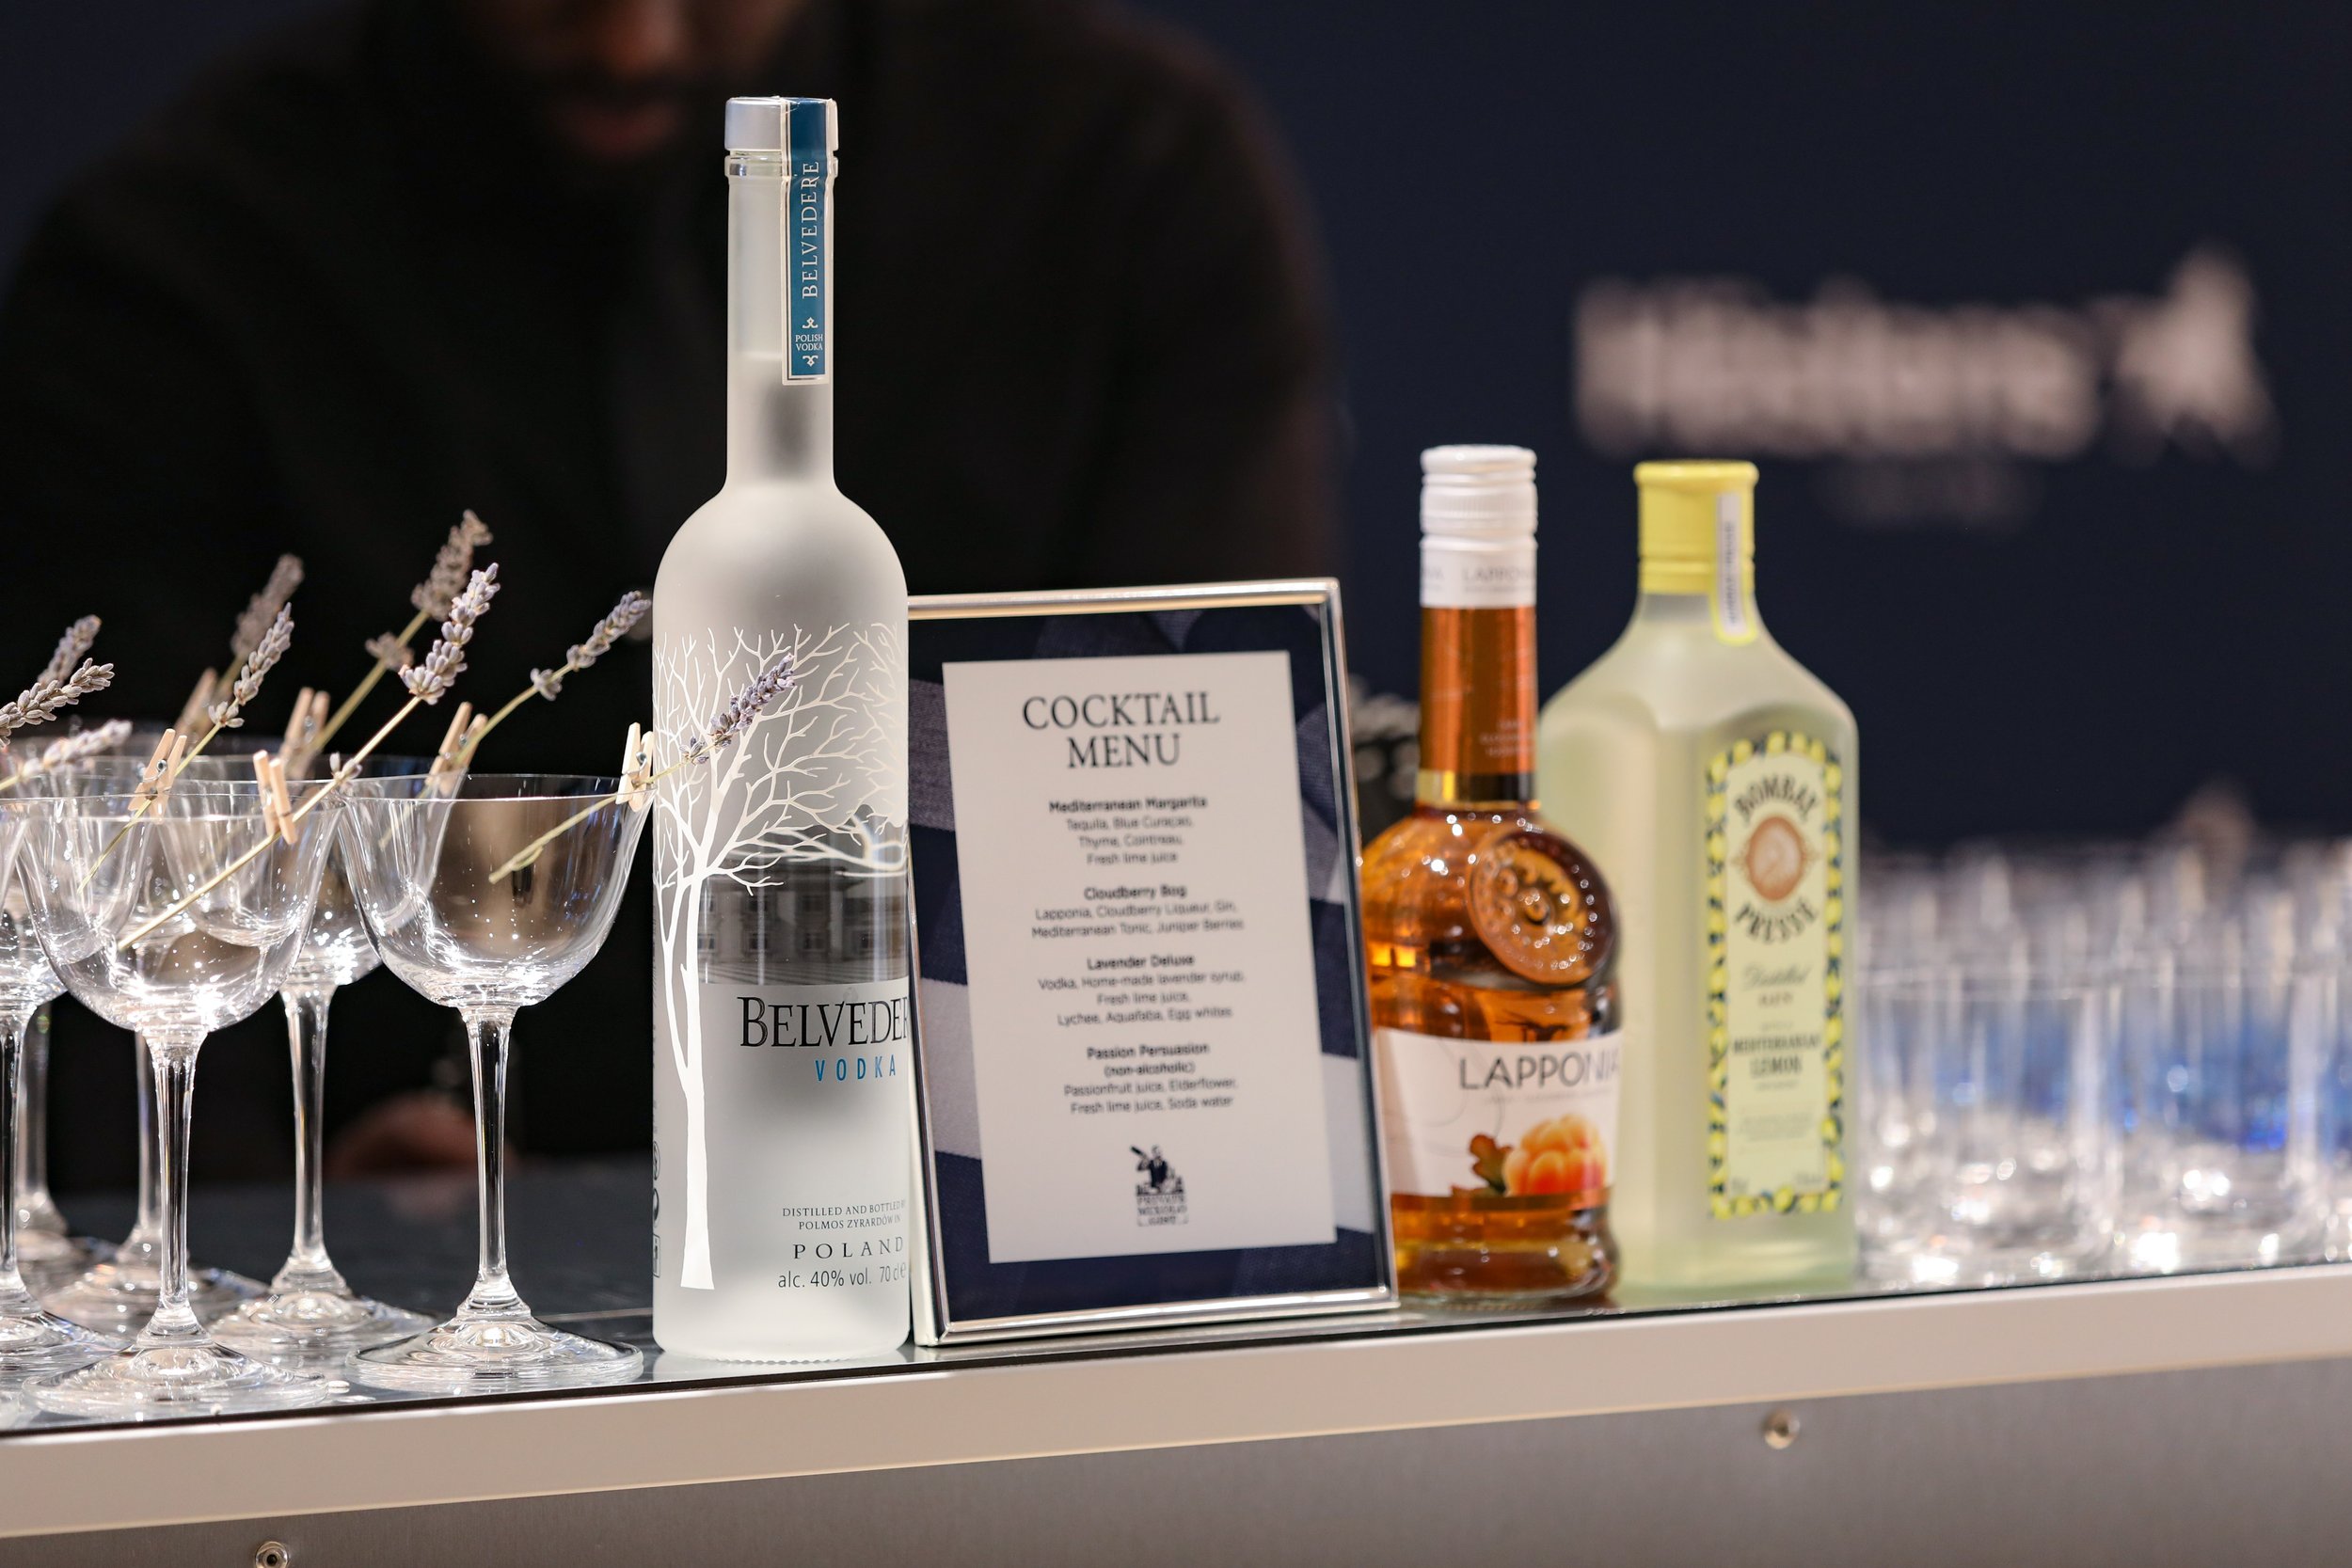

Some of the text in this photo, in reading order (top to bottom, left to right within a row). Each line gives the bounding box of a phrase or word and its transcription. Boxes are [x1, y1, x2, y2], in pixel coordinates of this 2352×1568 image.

[801, 162, 819, 299] BELVEDERE
[795, 334, 823, 342] POLISH
[1022, 690, 1221, 730] COCKTAIL
[1067, 733, 1181, 768] MENU
[1048, 797, 1207, 814] Mediterranean Margarita
[1734, 773, 1819, 824] BOMBAY
[1113, 816, 1138, 829] Blue
[1087, 851, 1178, 865] Fresh lime juice
[1084, 884, 1187, 901] Cloudberry Bog
[1096, 904, 1162, 919] Cloudberry
[1032, 925, 1116, 939] Mediterranean
[1156, 921, 1200, 935] Juniper
[1087, 954, 1196, 971] Lavender Deluxe
[1081, 974, 1153, 988] Home-made
[1158, 973, 1207, 986] lavender
[1096, 993, 1130, 1006] Fresh
[1134, 992, 1157, 1004] lime
[1168, 1009, 1192, 1022] Egg
[1087, 1042, 1210, 1060] Passion Persuasion
[815, 1054, 896, 1082] VODKA
[1104, 1061, 1196, 1077] (non-alcoholic)
[1063, 1083, 1131, 1097] Passionfruit
[1070, 1101, 1104, 1115] Fresh
[1106, 1101, 1131, 1113] lime
[1168, 1097, 1198, 1110] Soda
[1201, 1096, 1234, 1108] water
[783, 1207, 843, 1217] DISTILLED
[845, 1205, 867, 1215] AND
[869, 1201, 900, 1213] BOTTLED
[799, 1220, 844, 1230] POLMOS
[792, 1236, 903, 1259] POLAND
[778, 1271, 805, 1288] alc.
[810, 1270, 845, 1288] 40%
[850, 1267, 872, 1286] vol.
[880, 1266, 891, 1283] 70
